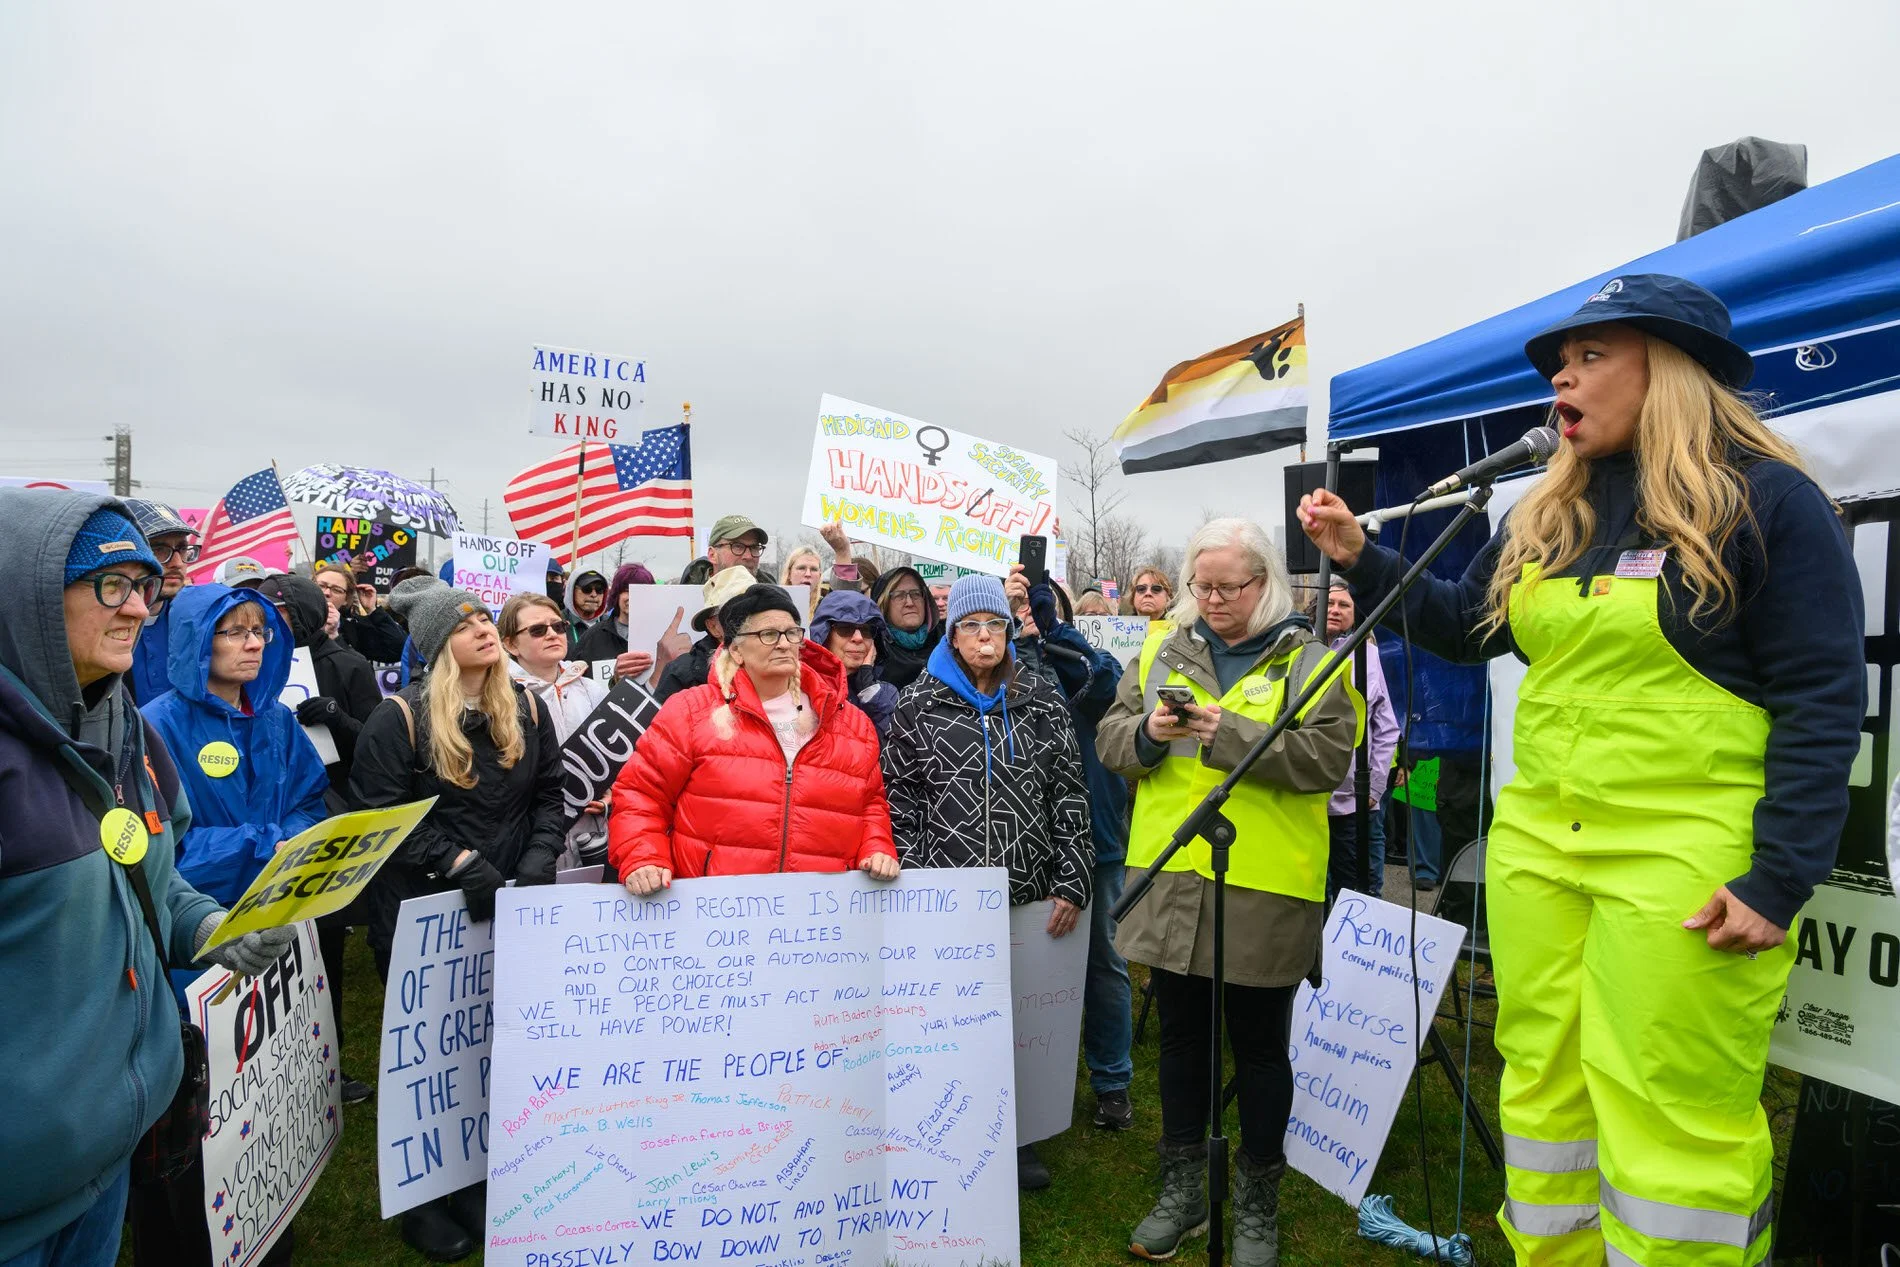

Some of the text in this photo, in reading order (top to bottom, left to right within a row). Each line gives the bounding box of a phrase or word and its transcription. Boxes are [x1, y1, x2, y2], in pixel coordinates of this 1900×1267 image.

[533, 350, 645, 383] AMERICA
[541, 382, 631, 410] HAS NO
[554, 413, 617, 439] KING
[820, 413, 910, 440] MEDICAID
[968, 442, 1050, 500] SECURITY
[993, 445, 1044, 487] SOCIAL
[828, 449, 1052, 535] HANDS OFF!
[318, 516, 383, 536] HANDS
[820, 494, 927, 541] WOMEN'S
[320, 533, 361, 550] OFF
[459, 536, 537, 558] HANDS OFF
[455, 569, 511, 590] SOCIAL
[483, 554, 519, 574] OUR
[914, 563, 949, 577] TRUMP
[1244, 683, 1273, 697] RESIST
[200, 754, 237, 766] RESIST
[113, 814, 139, 860] RESIST
[272, 825, 401, 878] RESIST
[226, 857, 384, 924] FASCISM
[515, 889, 1002, 926] THE TRUMP REGIME IS ATTEMPTING TO
[416, 907, 469, 957] THE
[564, 926, 842, 954] ALINATE OUR ALLIES
[1331, 898, 1436, 964] Remove
[564, 962, 606, 976] AND
[624, 956, 706, 972] CONTROL
[717, 954, 755, 968] OUR
[879, 946, 916, 960] OUR
[935, 943, 996, 960] VOICES
[1341, 949, 1376, 971] corrupt
[401, 950, 495, 1015] OF THE
[564, 971, 752, 997] AND OUR CHOICES!
[518, 981, 984, 1021] WE THE PEOPLE MUST ACT NOW WHILE WE
[841, 1007, 871, 1024] Bader
[1305, 976, 1407, 1044] Reverse
[387, 1000, 495, 1074] IS GREA
[526, 1014, 732, 1040] STILL HAVE POWER!
[208, 1057, 269, 1139] SOCIAL
[270, 976, 318, 1072] SECURITY
[884, 1041, 960, 1058] Gonzales
[1351, 1046, 1392, 1070] policies
[251, 1024, 313, 1138] MEDICARE
[533, 1049, 805, 1092] WE ARE THE PEOPLE
[406, 1066, 460, 1121] THE
[690, 1091, 787, 1113] Thomas Jefferson
[839, 1098, 874, 1123] Henry
[917, 1078, 962, 1138] Elizabeth
[222, 1047, 325, 1199] VOTING RIGHTS
[559, 1123, 589, 1137] Ida
[616, 1115, 653, 1130] Wells
[845, 1125, 887, 1141] Cassidy
[986, 1087, 1009, 1144] Harris
[235, 1076, 330, 1221] CONSTITUTION
[585, 1143, 605, 1160] Liz
[640, 1133, 698, 1151] Josefina
[738, 1125, 753, 1137] de
[1287, 1115, 1369, 1185] emocracy
[391, 1127, 443, 1188] IN
[490, 1134, 553, 1181] Medgar Evers
[645, 1150, 720, 1195] John Lewis
[241, 1106, 327, 1255] DEMOCRACY
[533, 1202, 556, 1221] Fred
[637, 1197, 671, 1209] Larry
[641, 1209, 676, 1231] WE
[701, 1208, 732, 1228] DO
[794, 1200, 825, 1220] AND
[834, 1182, 882, 1212] WILL
[891, 1179, 938, 1200] NOT
[526, 1241, 635, 1267] PASSIVLY
[653, 1239, 702, 1262] BOW
[720, 1233, 780, 1259] DOWN
[799, 1227, 822, 1249] TO
[837, 1210, 933, 1240] TYRANNY
[893, 1235, 985, 1251] Jamie Raskin
